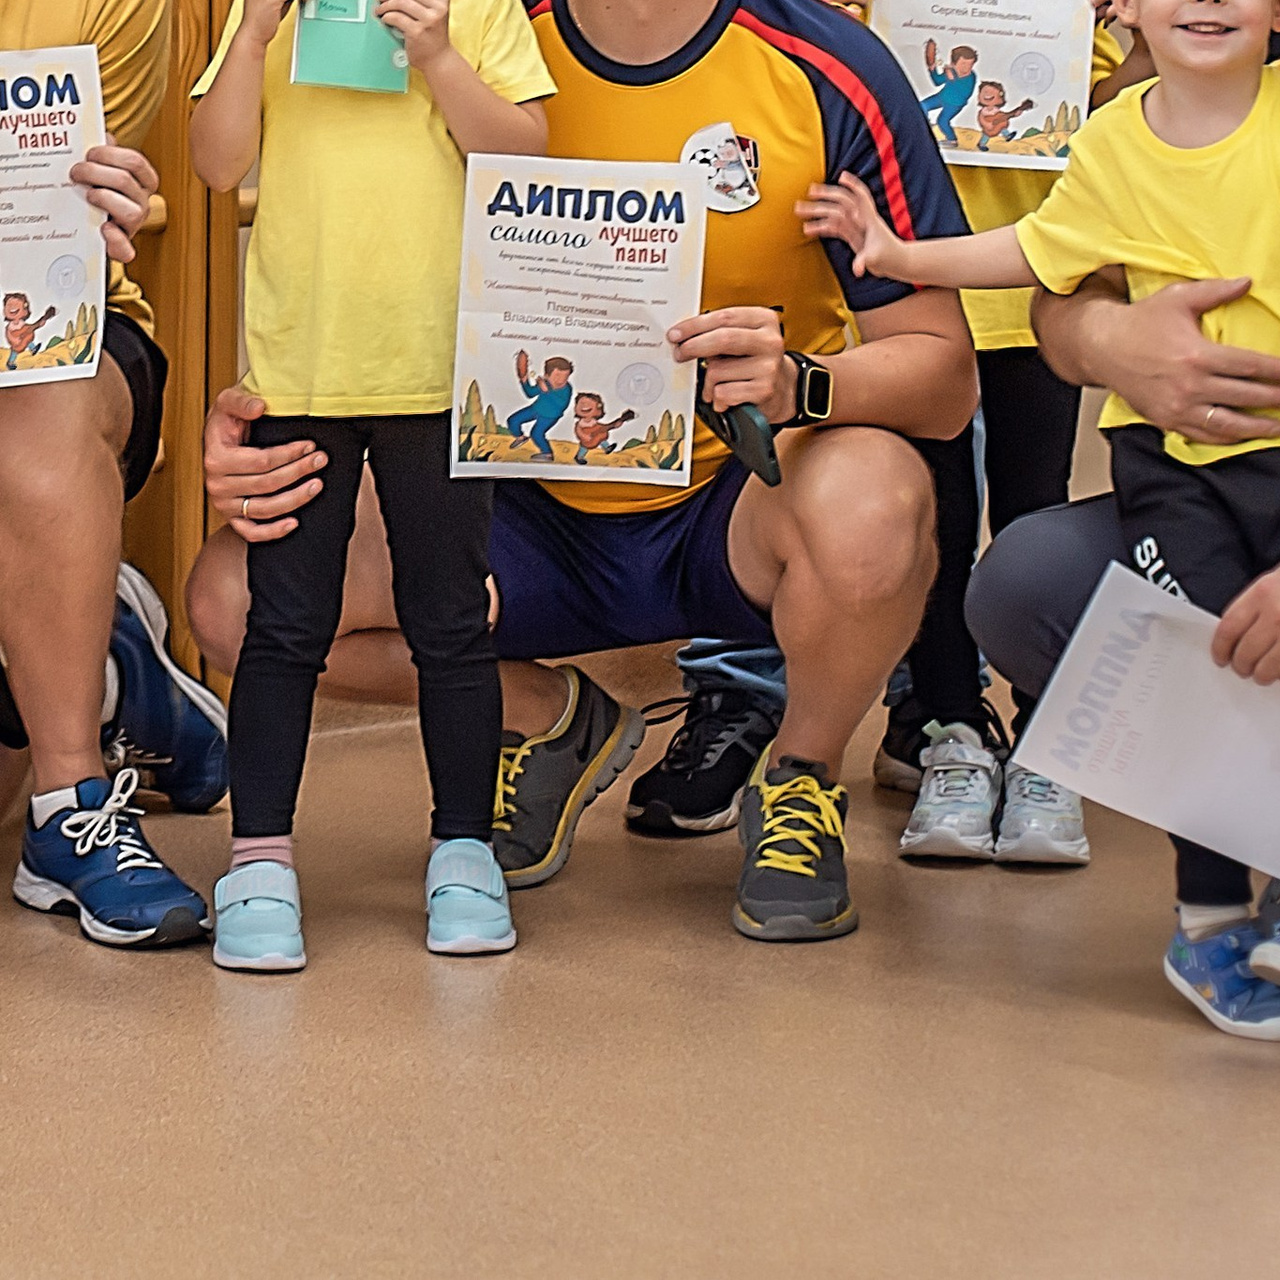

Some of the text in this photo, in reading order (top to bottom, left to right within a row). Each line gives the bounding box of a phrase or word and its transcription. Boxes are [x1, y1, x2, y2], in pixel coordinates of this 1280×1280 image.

[0, 110, 77, 135] лучшего
[18, 131, 69, 150] папы
[487, 181, 686, 224] ДИПЛОМ
[489, 224, 679, 250] самого лучшего
[615, 247, 667, 264] папы
[503, 311, 562, 327] Владимир
